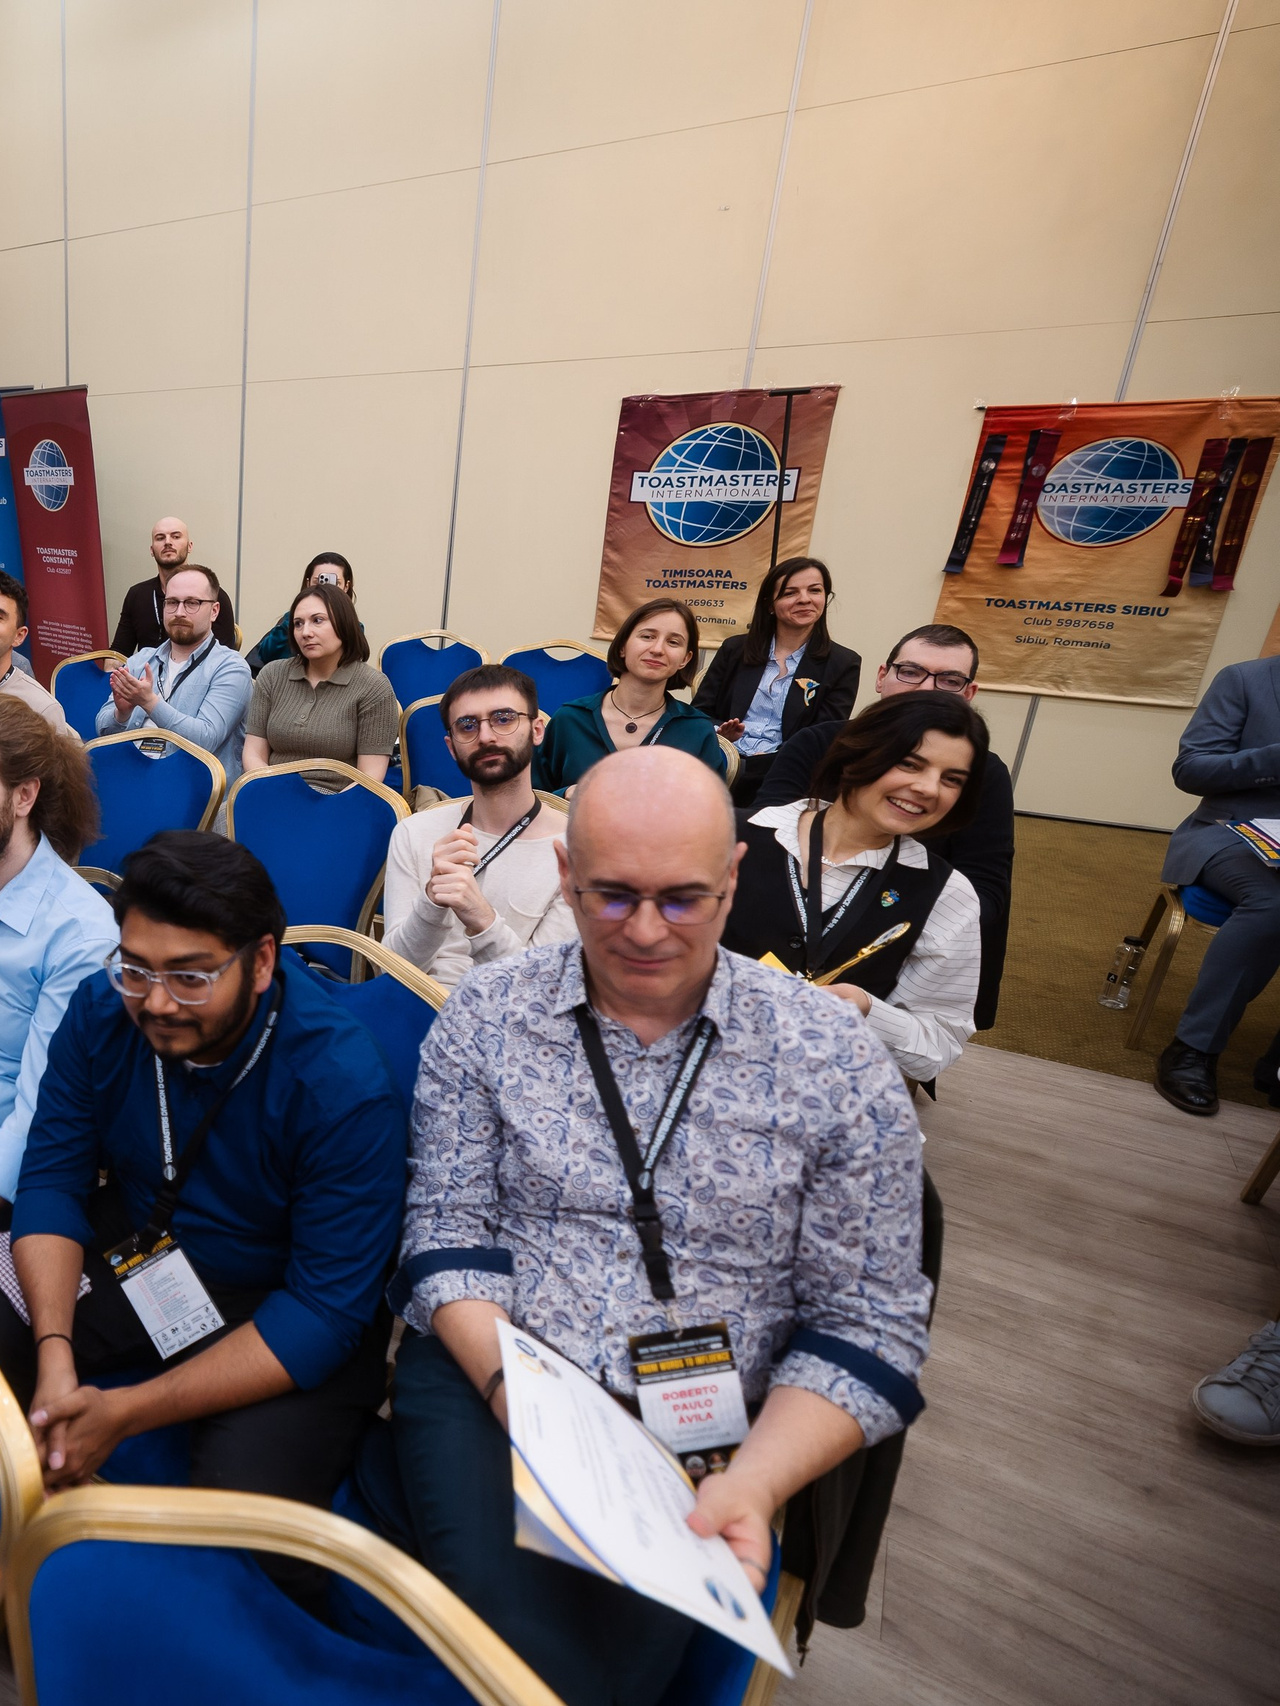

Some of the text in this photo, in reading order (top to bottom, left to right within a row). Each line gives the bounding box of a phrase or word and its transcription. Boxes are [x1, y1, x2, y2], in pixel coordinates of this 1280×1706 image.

[26, 469, 72, 478] TOASTMASTERS
[638, 473, 791, 490] TOASTMASTERS
[651, 488, 770, 499] INTERNATIONAL
[1041, 482, 1192, 495] OASTMASTERS
[1042, 494, 1170, 504] INTERNATIONAL
[36, 547, 78, 557] TOASTMASTERS
[662, 568, 732, 580] TIMISOARA
[645, 578, 748, 590] TOASTMASTERS
[684, 599, 724, 608] 1269633
[984, 597, 1170, 618] TOASTMASTERS SIBIU
[695, 616, 736, 626] Romania
[1023, 617, 1114, 630] Club 5987658
[1014, 635, 1111, 650] Sibiu, Romania
[662, 1385, 718, 1401] ROBERTO
[672, 1399, 713, 1412] PAULO
